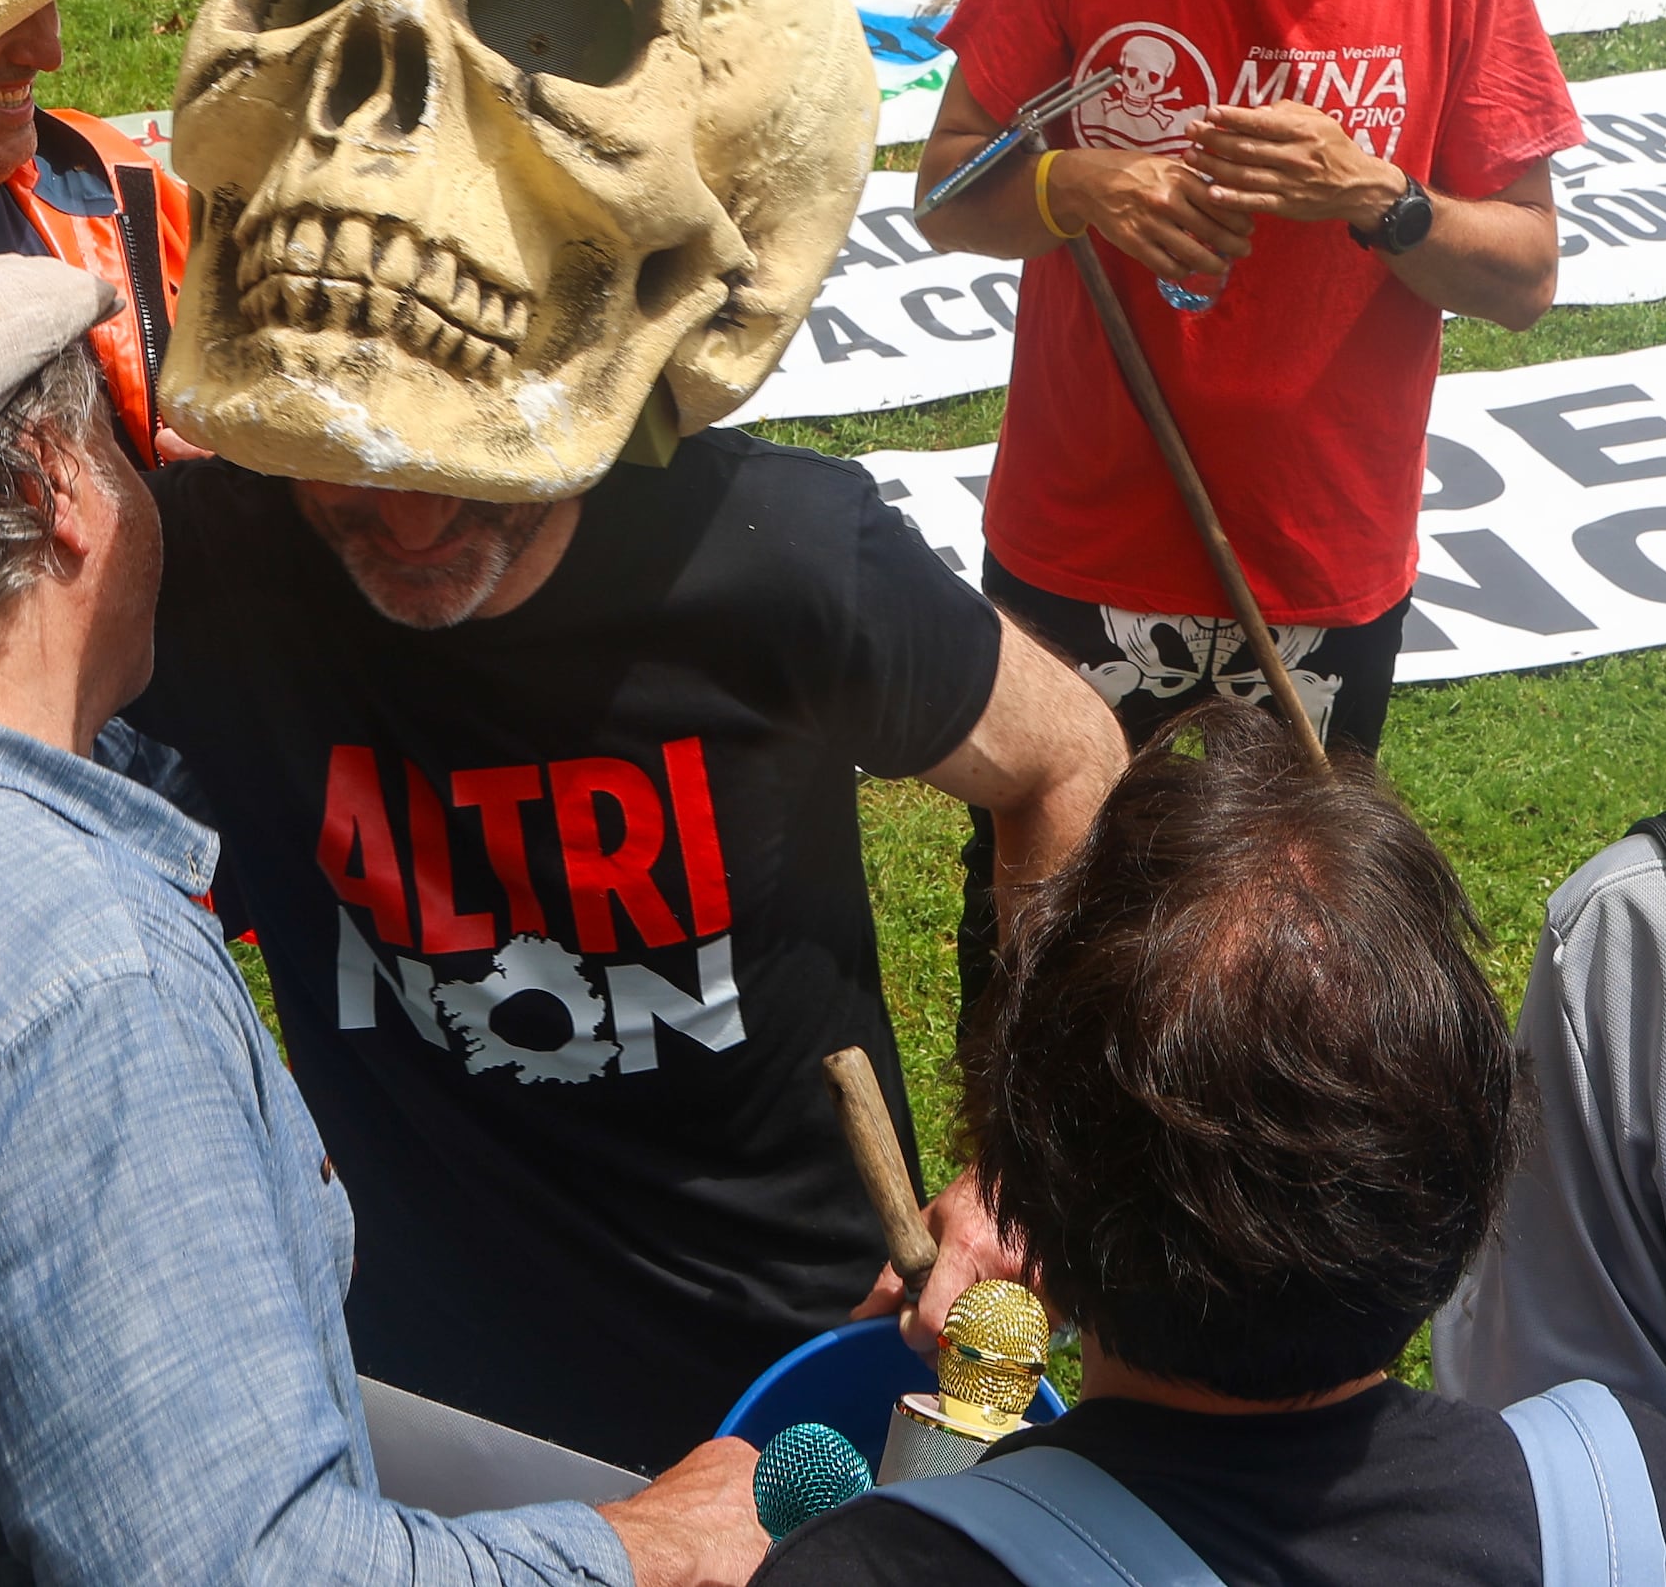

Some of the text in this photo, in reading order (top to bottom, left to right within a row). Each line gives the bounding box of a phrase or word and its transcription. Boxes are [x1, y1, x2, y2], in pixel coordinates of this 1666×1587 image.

[1227, 57, 1408, 109] MINA
[1248, 44, 1402, 61] Plataforma Veciñal
[1348, 107, 1407, 129] PINO
[899, 272, 1021, 342] CO
[316, 735, 732, 956] ALTRI
[336, 904, 748, 1087] NON
